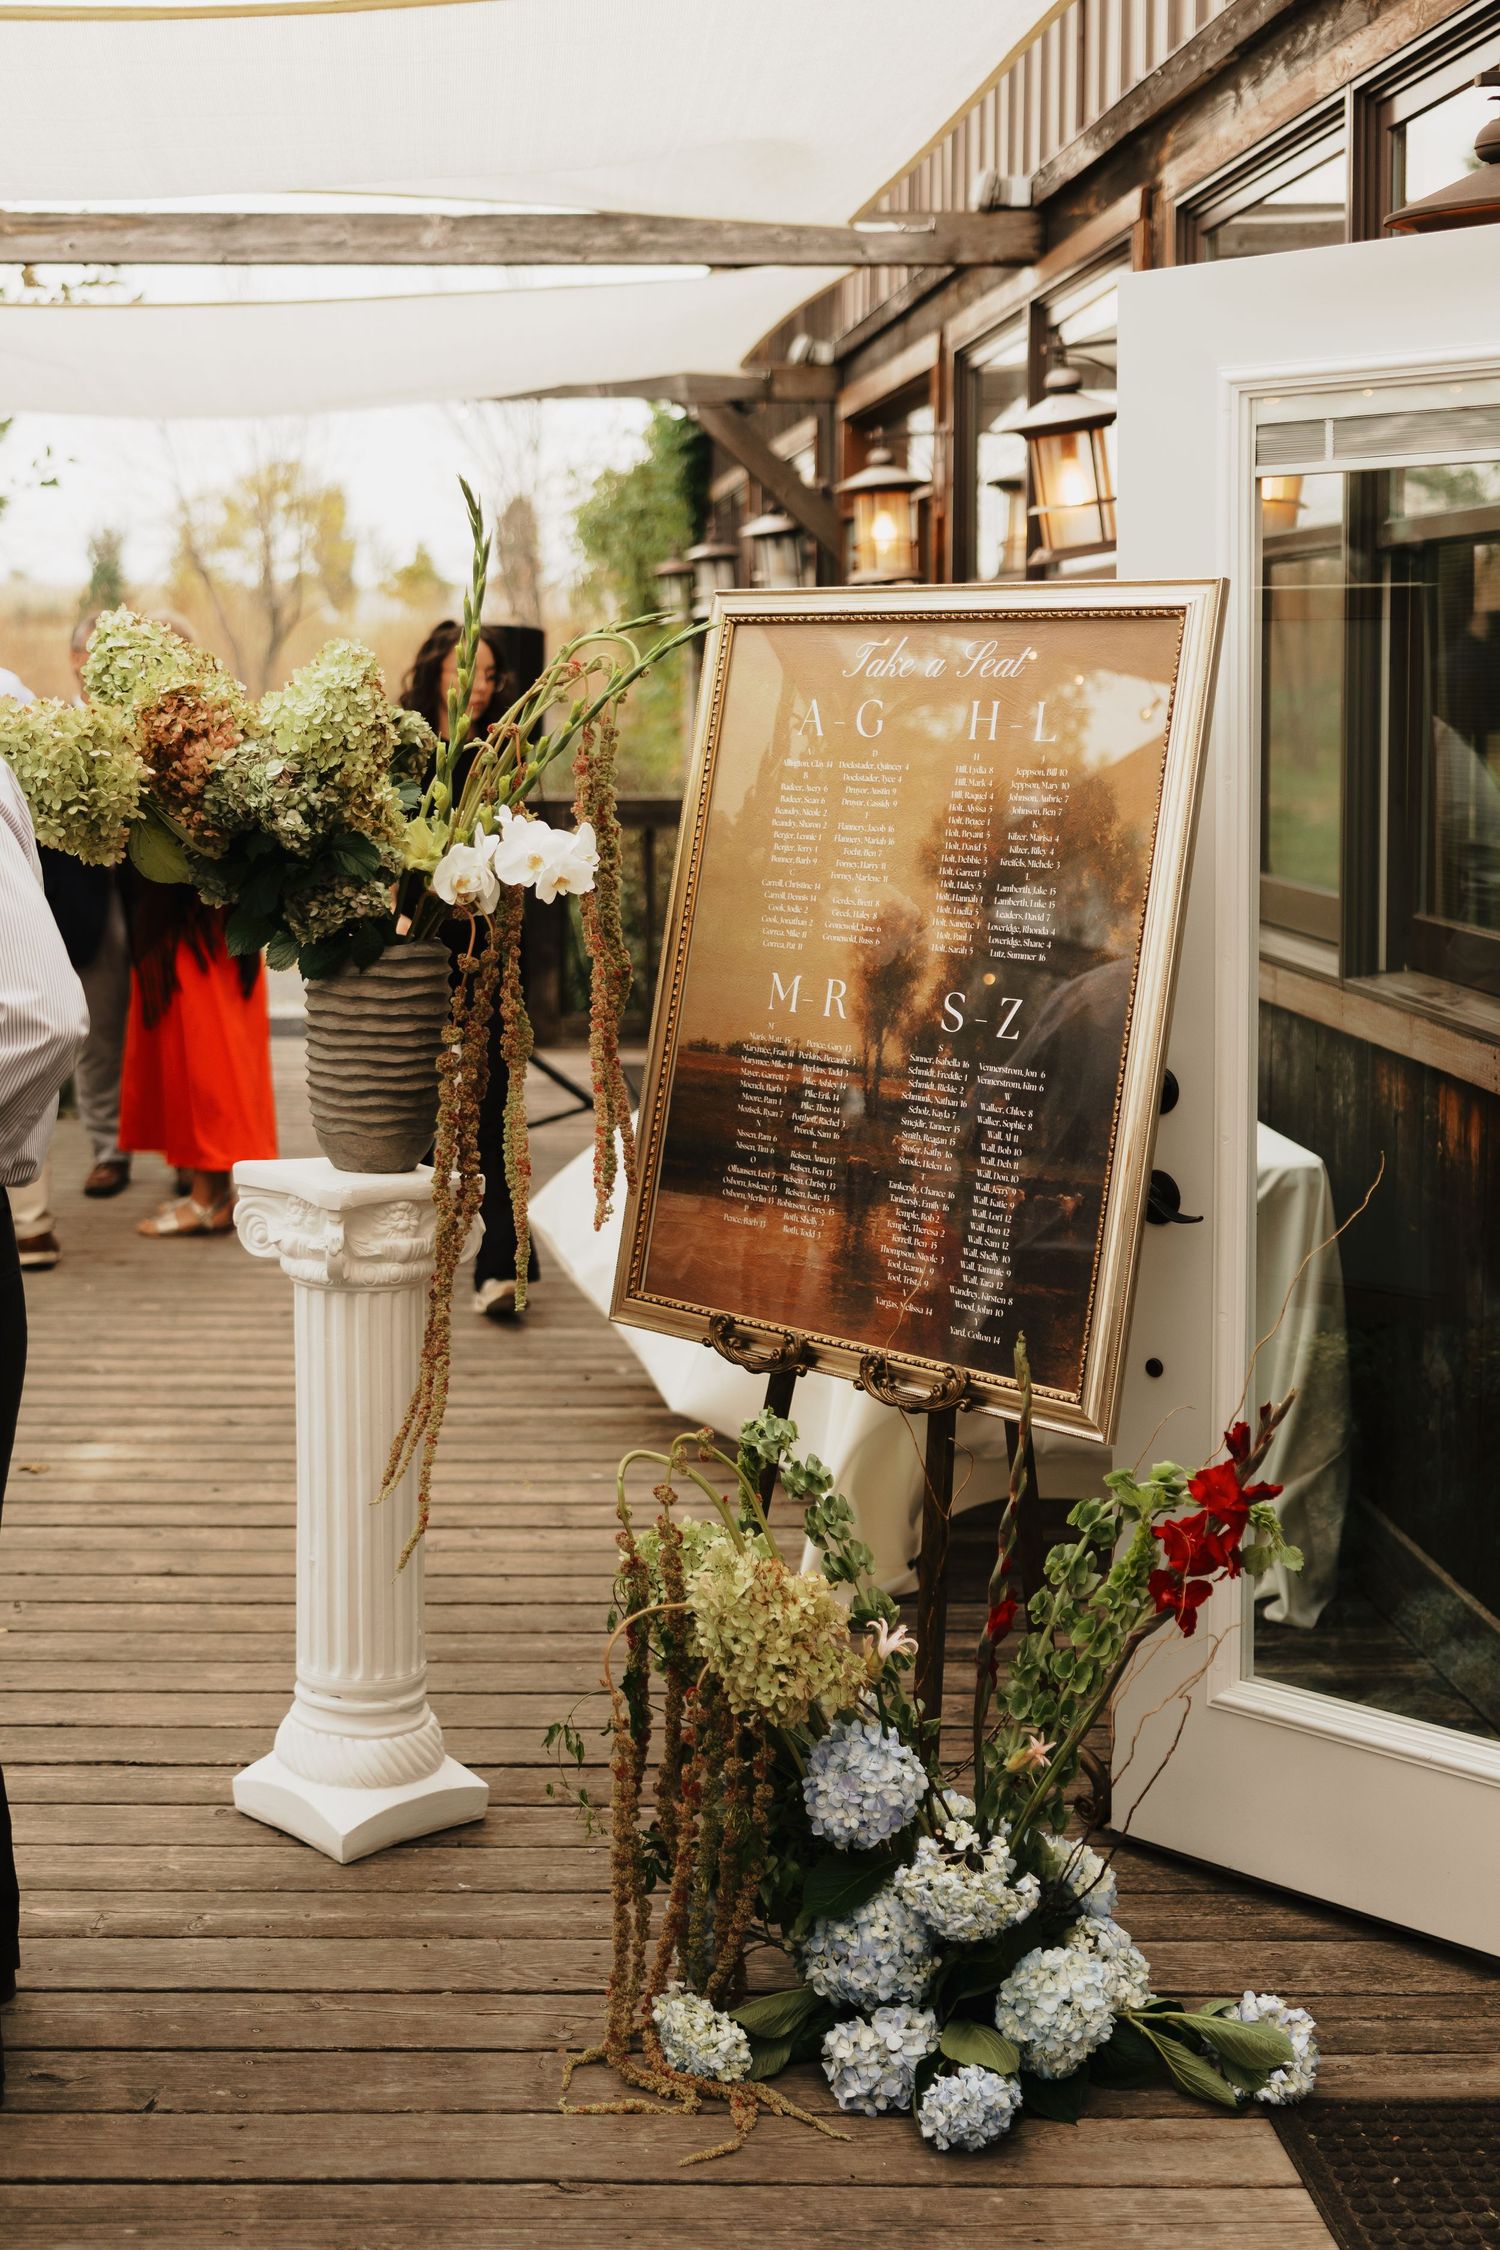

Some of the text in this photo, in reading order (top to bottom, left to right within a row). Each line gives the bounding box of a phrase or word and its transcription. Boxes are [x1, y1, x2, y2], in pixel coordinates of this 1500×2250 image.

[842, 637, 1033, 678] Take a Seat
[798, 699, 824, 736] A
[856, 699, 884, 738] G
[968, 700, 1000, 740] H
[1033, 701, 1057, 742] L
[768, 972, 802, 1012] M
[823, 978, 848, 1020] R
[940, 992, 966, 1032] S
[996, 998, 1024, 1040] Z
